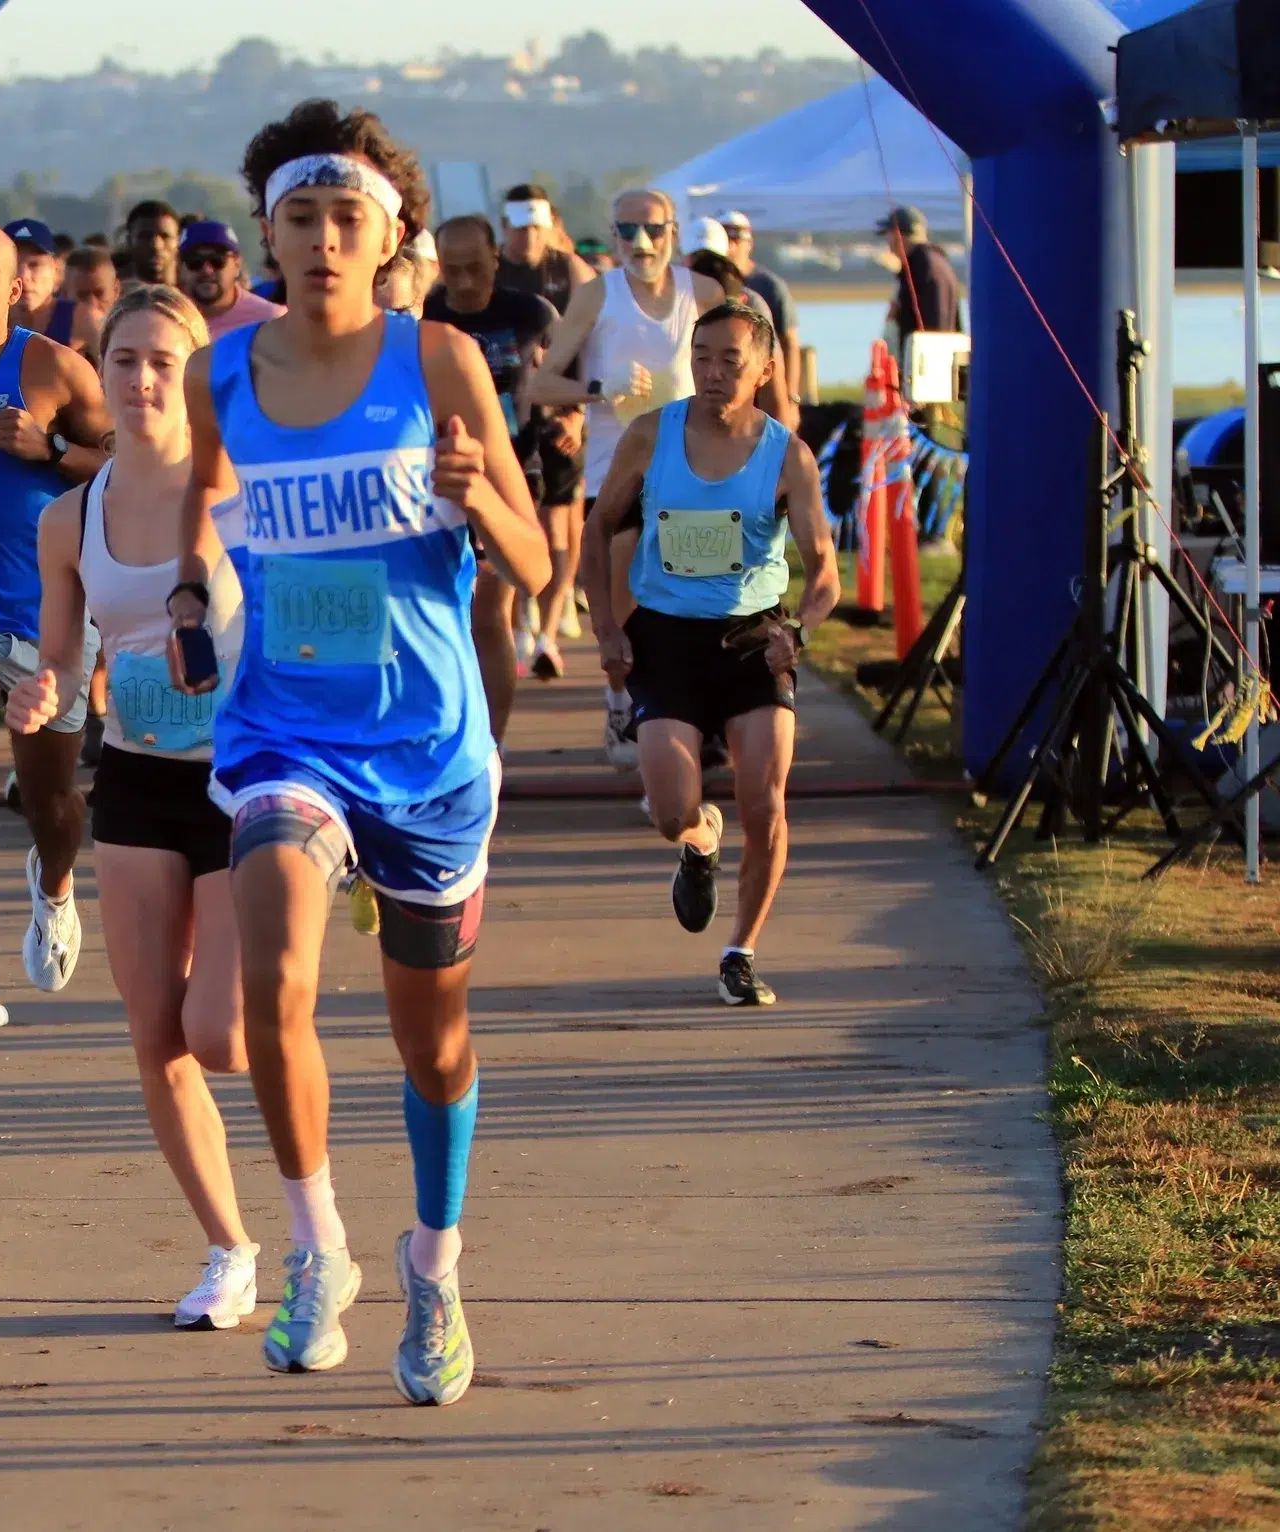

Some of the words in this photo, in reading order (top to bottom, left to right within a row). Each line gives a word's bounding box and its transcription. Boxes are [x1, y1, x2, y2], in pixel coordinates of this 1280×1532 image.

[666, 524, 733, 558] 1427
[269, 581, 381, 635] 1089
[119, 675, 213, 727] 1010
